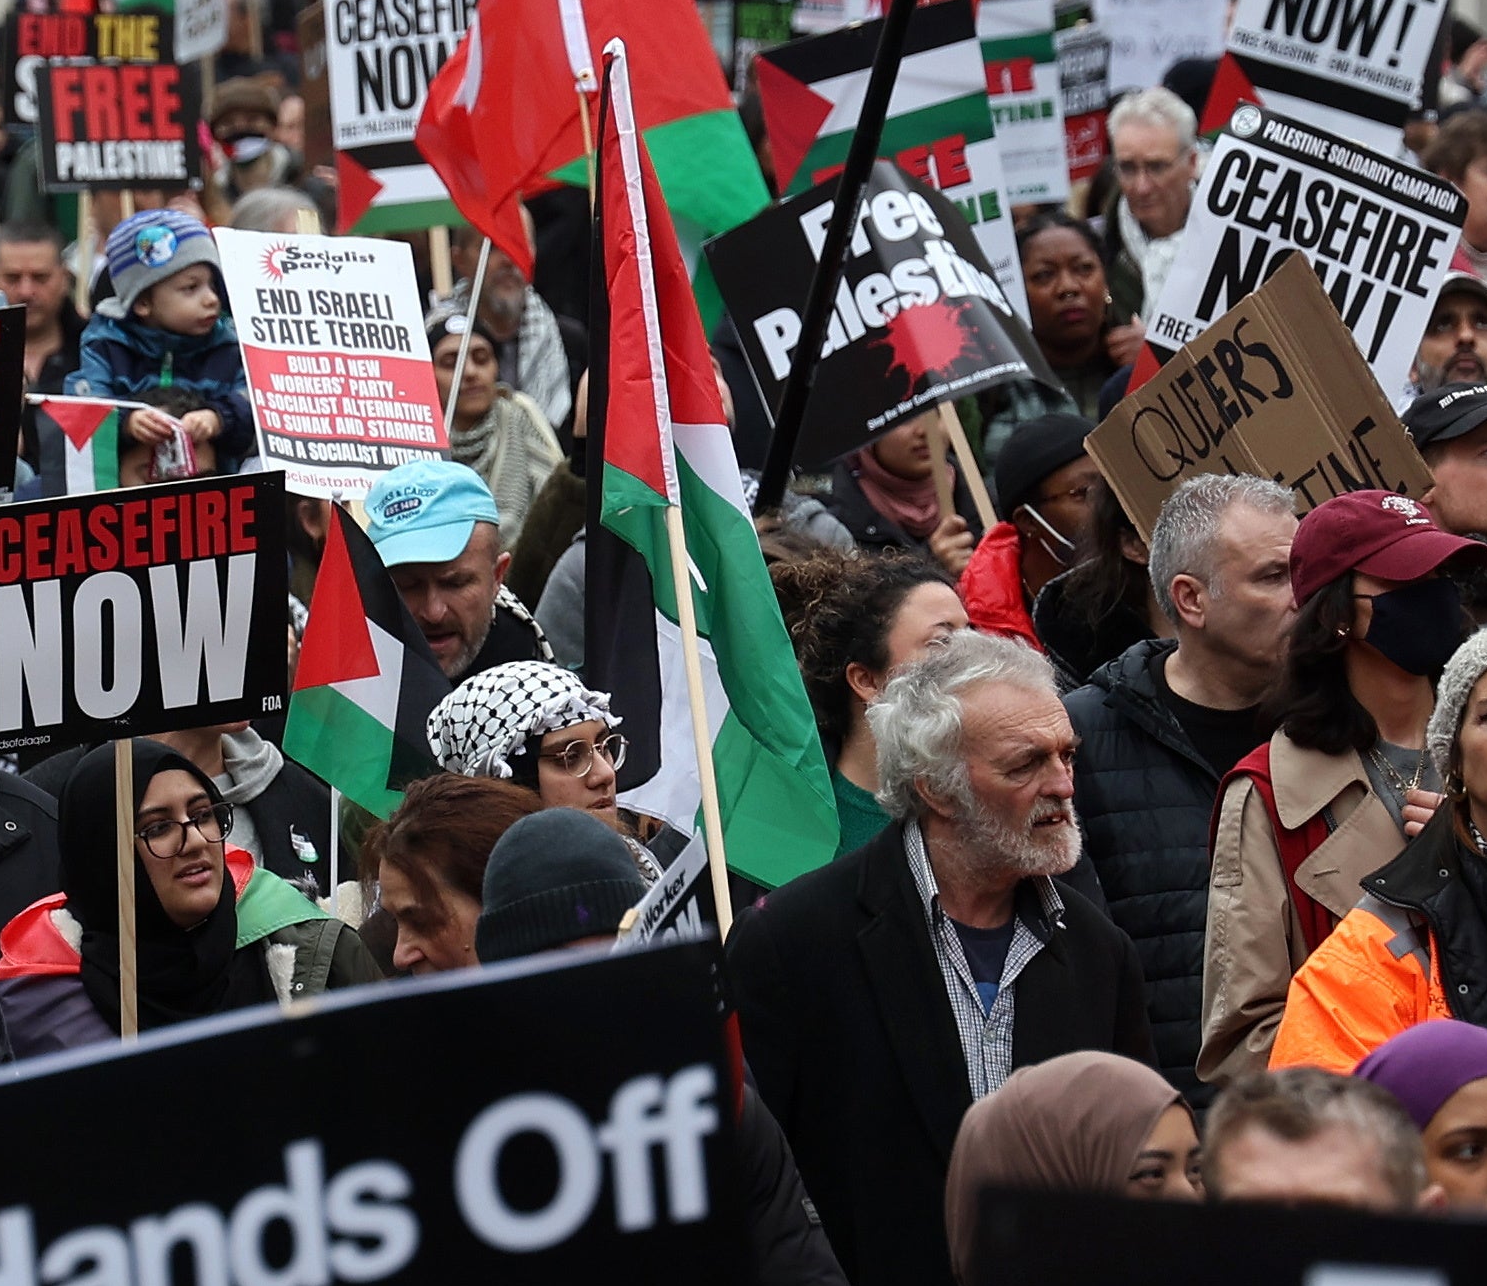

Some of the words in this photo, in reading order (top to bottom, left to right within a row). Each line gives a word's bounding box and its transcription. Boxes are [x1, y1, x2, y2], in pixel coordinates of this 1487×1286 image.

[18, 15, 86, 56] END
[94, 15, 160, 61] THE
[50, 64, 184, 141] FREE
[56, 140, 187, 182] PALESTINE
[1262, 119, 1331, 158] PALESTINE
[1327, 144, 1394, 185] SOLIDARITY
[1391, 169, 1458, 214] CAMPAIGN
[800, 187, 944, 258] Free
[1206, 147, 1451, 298] CEASEFIRE
[286, 247, 376, 264] Socialist
[256, 288, 302, 314] END
[308, 289, 394, 321] ISRAELI
[251, 316, 320, 345] STATE
[328, 320, 412, 353] TERROR
[270, 373, 346, 396] WORKERS'
[350, 378, 394, 398] PARTY
[287, 356, 331, 374] BUILD
[348, 359, 381, 377] NEW
[268, 392, 338, 414] SOCIALIST
[342, 396, 434, 423] ALTERNATIVE
[1130, 315, 1295, 483] QUEERS
[368, 421, 436, 443] STARMER
[309, 441, 379, 464] SOCIALIST
[452, 1061, 721, 1255] Off
